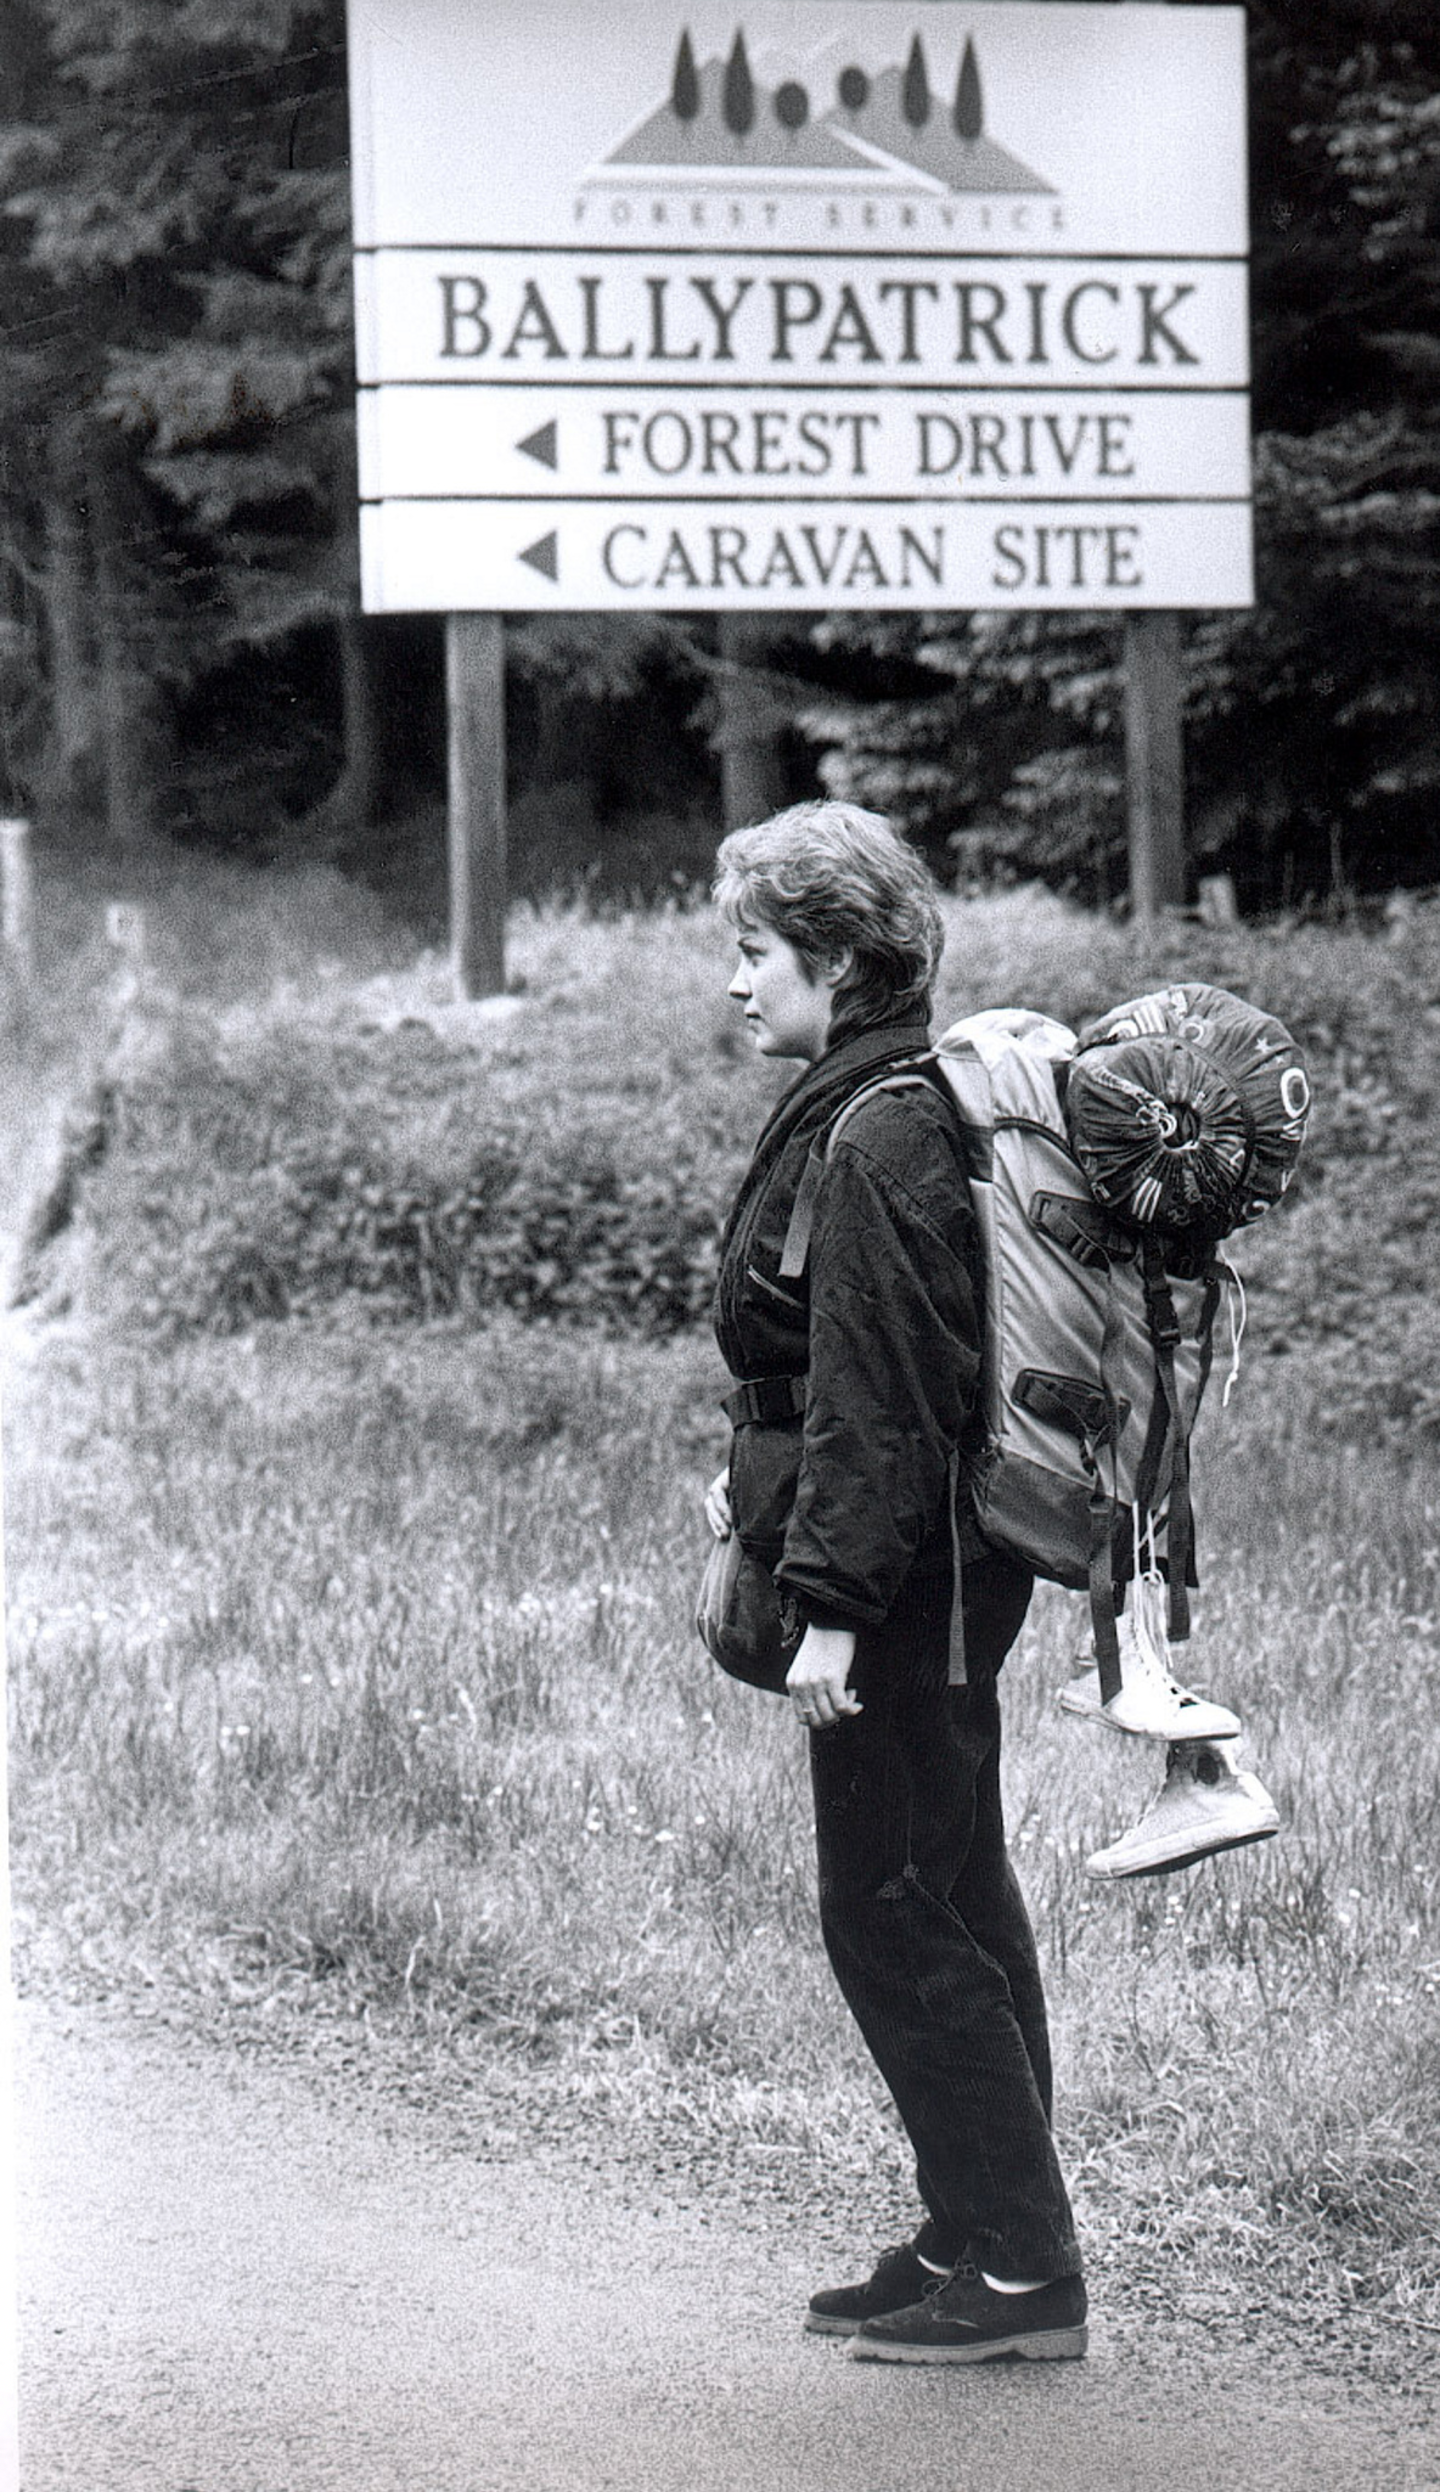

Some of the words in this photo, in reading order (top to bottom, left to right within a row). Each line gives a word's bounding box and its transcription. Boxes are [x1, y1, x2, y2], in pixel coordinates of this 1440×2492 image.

[574, 198, 780, 226] FOREST
[827, 203, 1067, 230] SERVICE
[437, 276, 1201, 366] BALLYPATRICK
[602, 411, 879, 477] FOREST
[916, 414, 1136, 478] DRIVE
[602, 524, 945, 589] CARAVAN
[994, 527, 1142, 589] SITE
